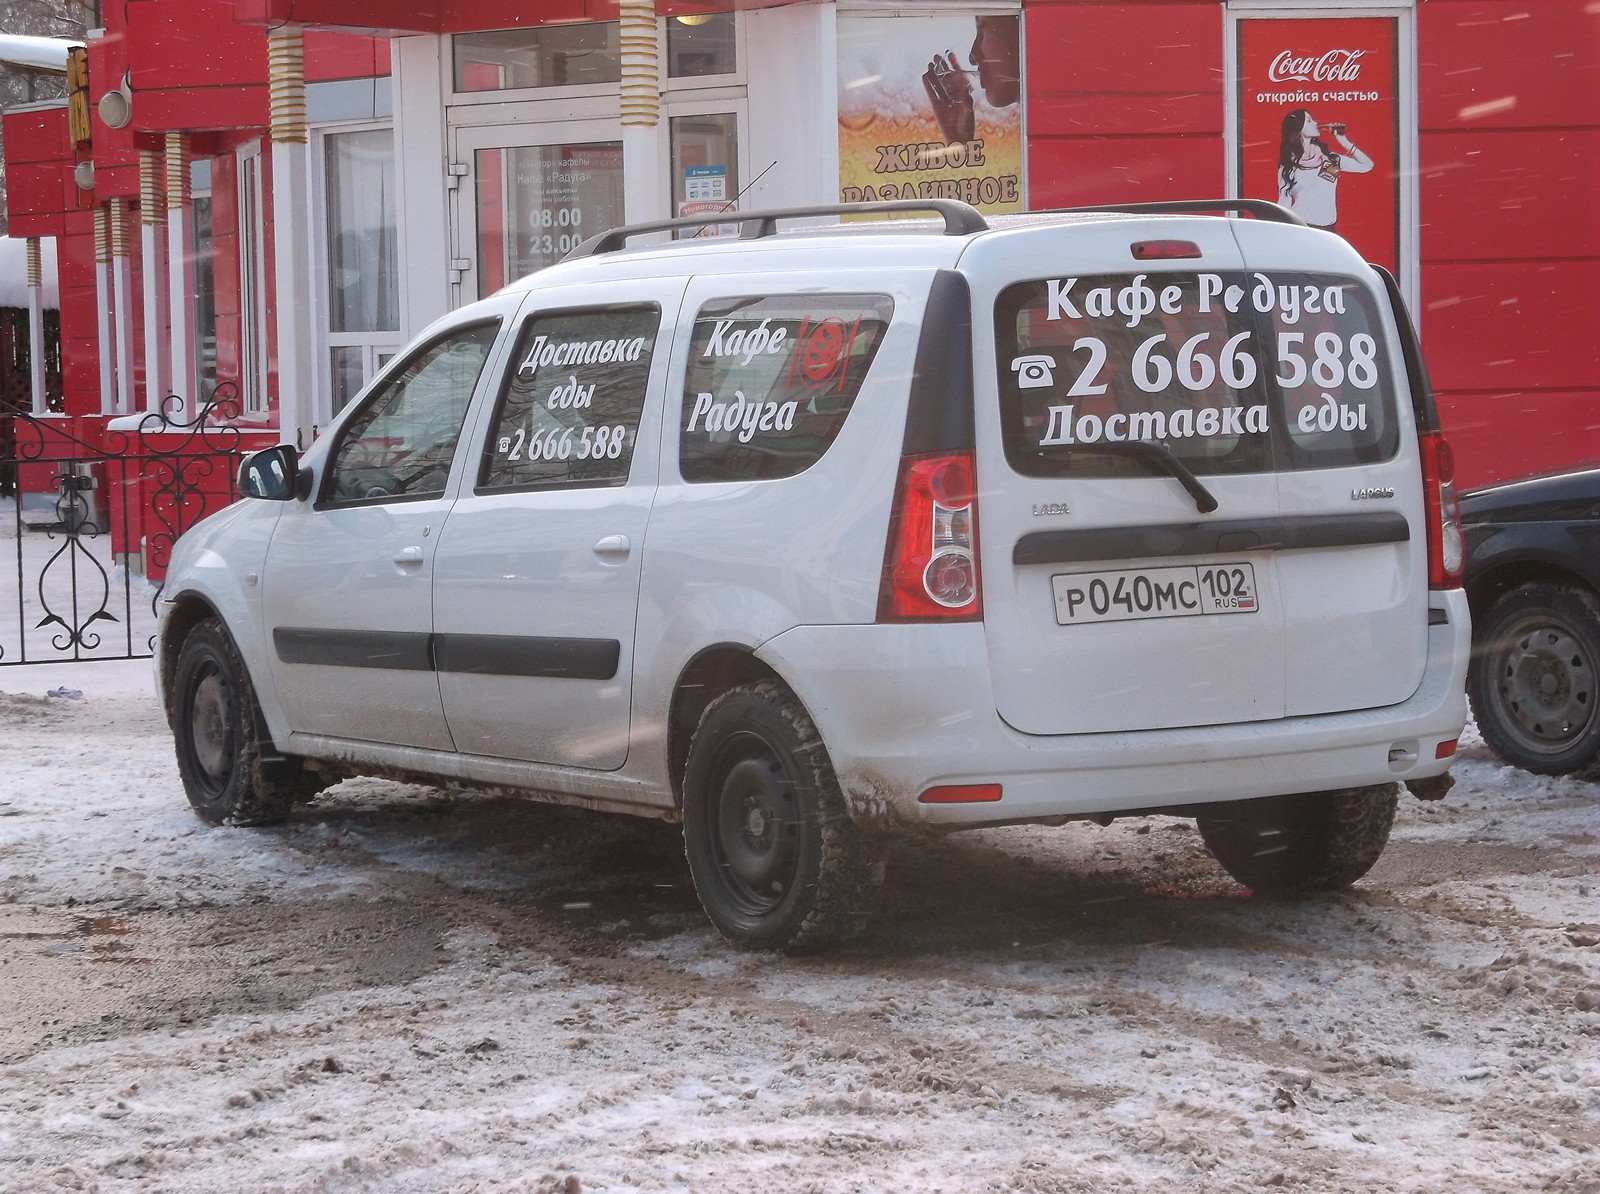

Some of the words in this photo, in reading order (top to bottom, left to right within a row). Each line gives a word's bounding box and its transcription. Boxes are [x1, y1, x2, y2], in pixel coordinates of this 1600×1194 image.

[1269, 49, 1366, 83] Coca-Cola
[1256, 90, 1319, 105] откройся
[1322, 91, 1379, 103] счастью
[875, 139, 986, 173] ЖИВОЕ
[529, 208, 581, 228] 08.00
[530, 233, 583, 255] 23.00
[1046, 274, 1183, 329] Кафе
[518, 335, 645, 375] Доставка
[703, 318, 788, 367] Кафе
[1066, 337, 1109, 397] 2
[1131, 331, 1257, 393] 666
[1275, 331, 1378, 389] 588
[547, 376, 595, 411] еды
[686, 391, 799, 444] Радуга
[1039, 401, 1270, 447] Доставка
[1297, 392, 1368, 433] еды
[508, 429, 525, 461] 2
[528, 426, 573, 461] 666
[578, 425, 626, 460] 588
[1032, 503, 1070, 516] LADA
[1202, 568, 1248, 598] 102
[1215, 598, 1237, 608] RUS
